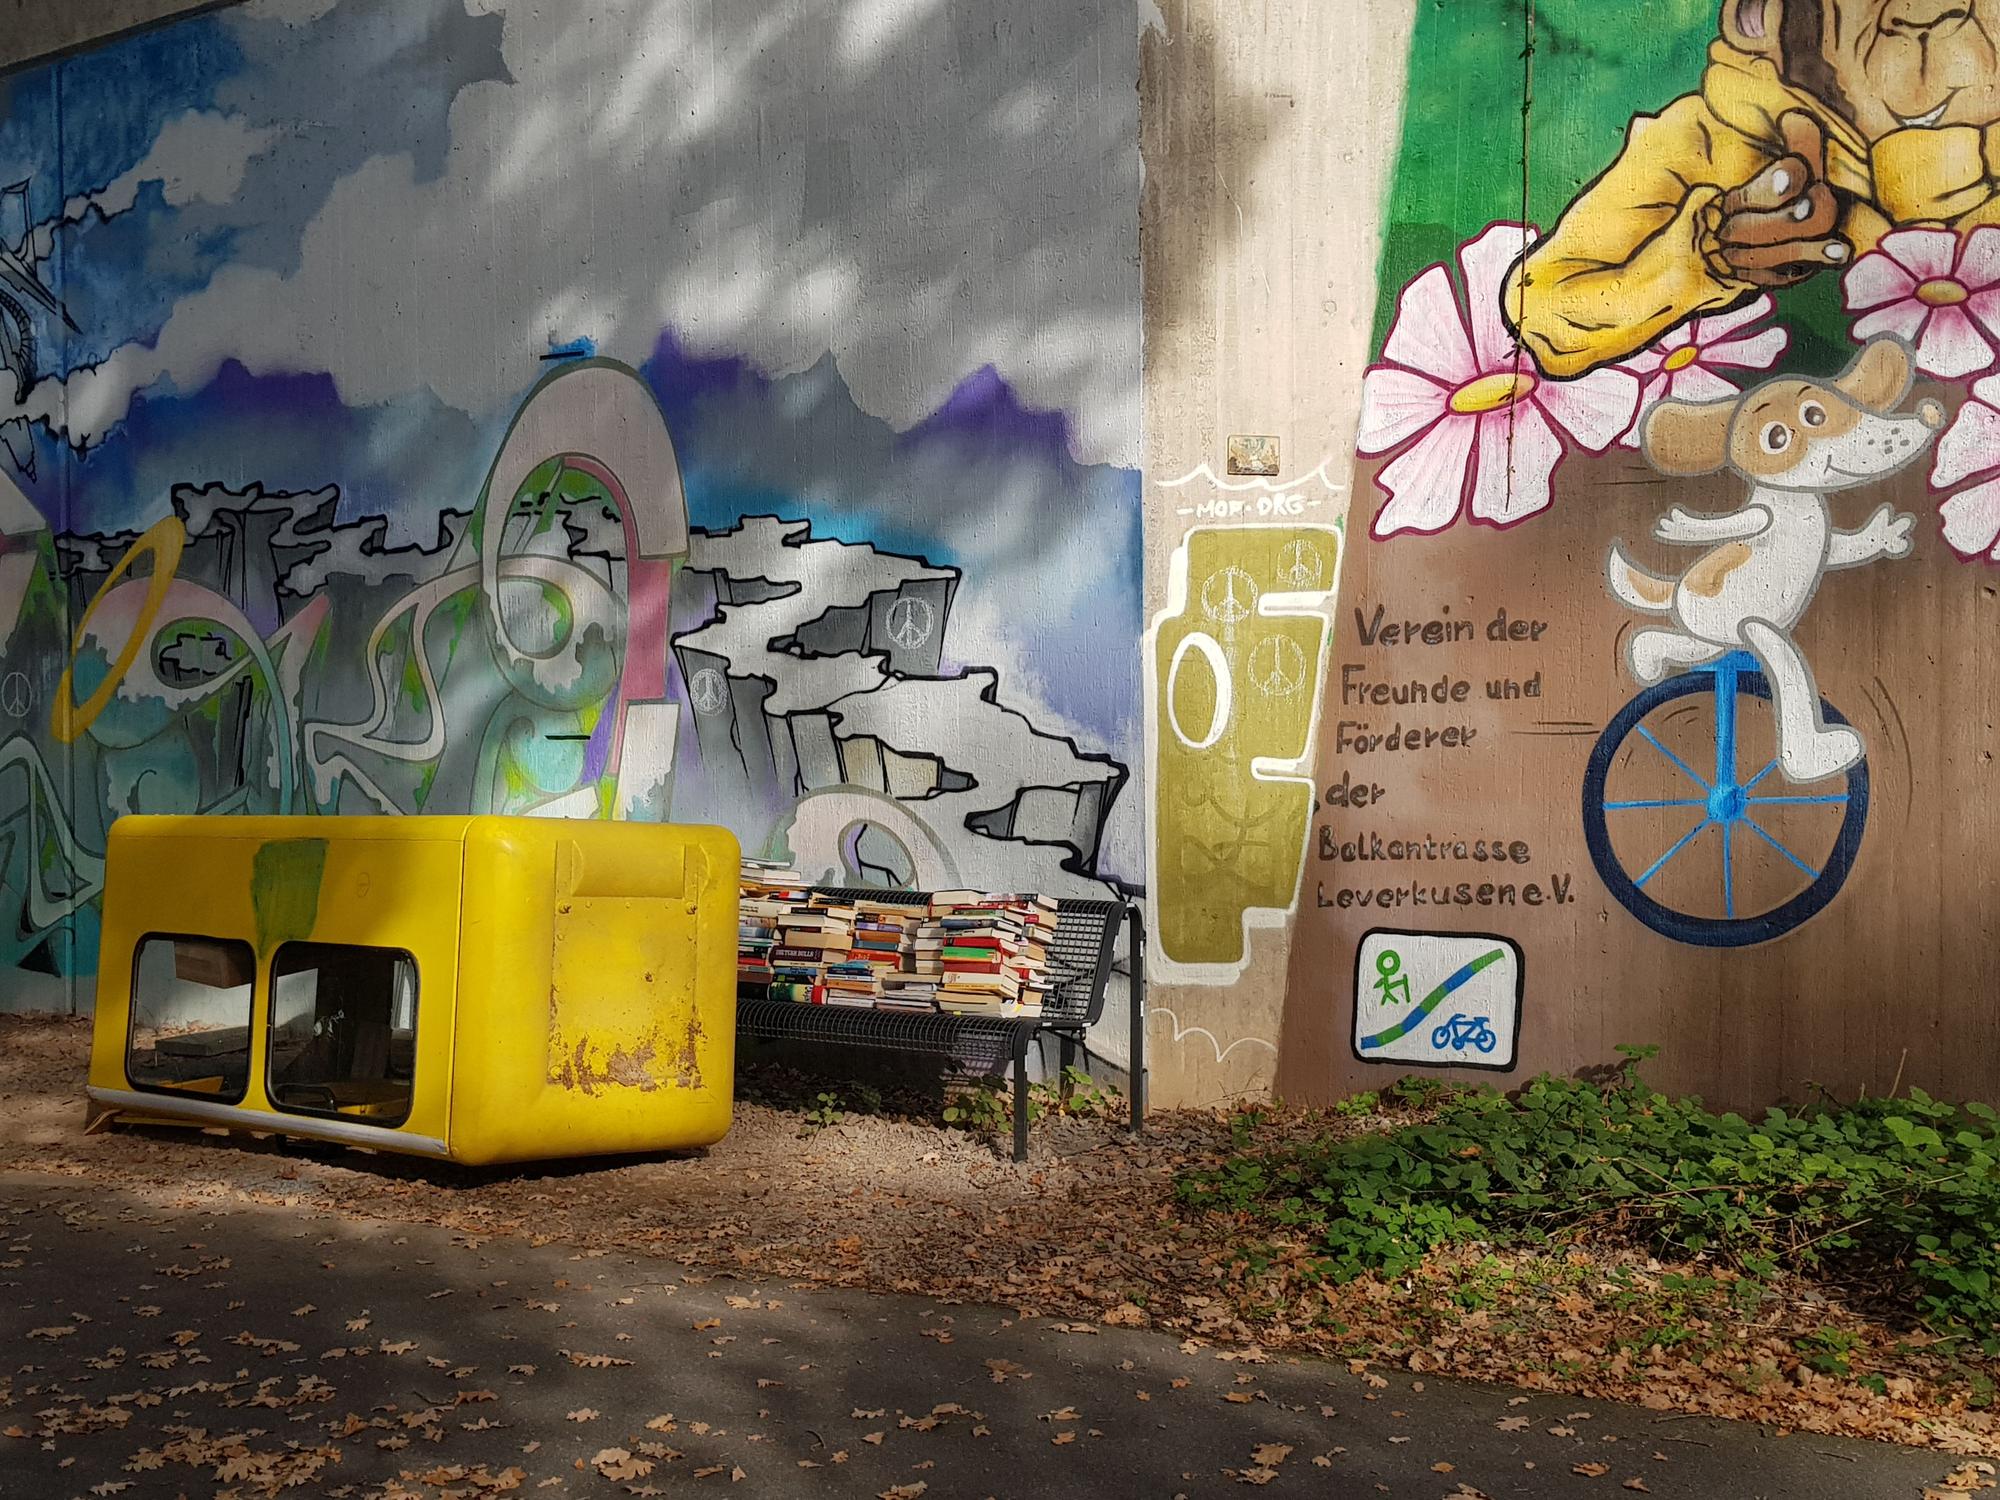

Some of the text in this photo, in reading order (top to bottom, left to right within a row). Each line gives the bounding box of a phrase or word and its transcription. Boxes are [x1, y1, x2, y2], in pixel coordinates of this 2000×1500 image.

[1354, 603, 1548, 646] Verein der
[1341, 663, 1542, 705] Freunde und
[1336, 720, 1477, 754] Förderer
[1325, 769, 1386, 809] der
[1317, 824, 1531, 864] Balkantrasse
[1316, 872, 1575, 909] Leverkusen e.V.
